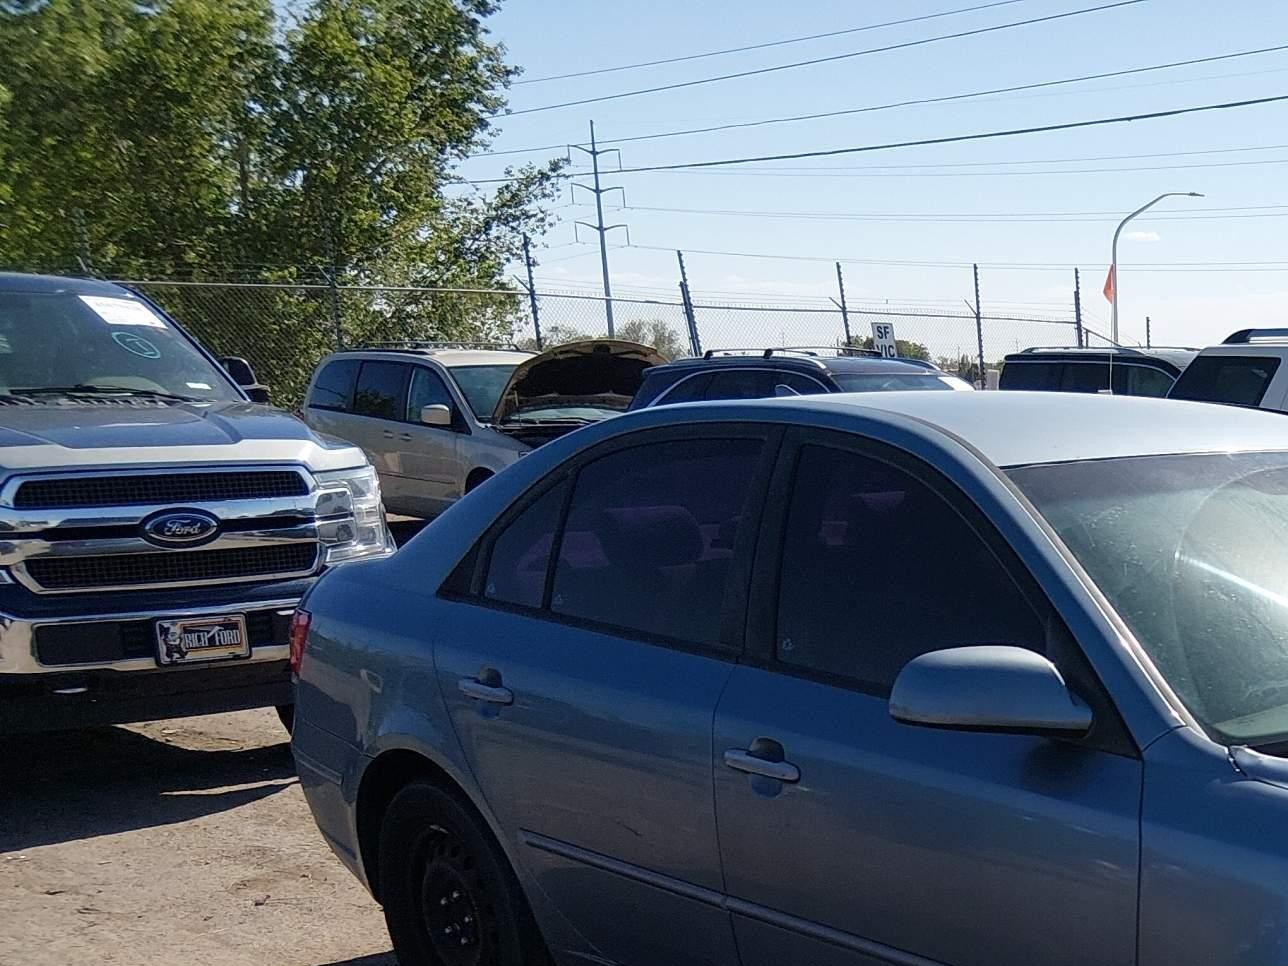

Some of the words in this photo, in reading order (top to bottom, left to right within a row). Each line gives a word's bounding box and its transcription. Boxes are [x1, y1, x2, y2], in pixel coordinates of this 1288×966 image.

[876, 325, 890, 339] SF
[163, 518, 201, 536] Ford
[184, 631, 209, 649] RICH
[214, 629, 241, 646] FORD
